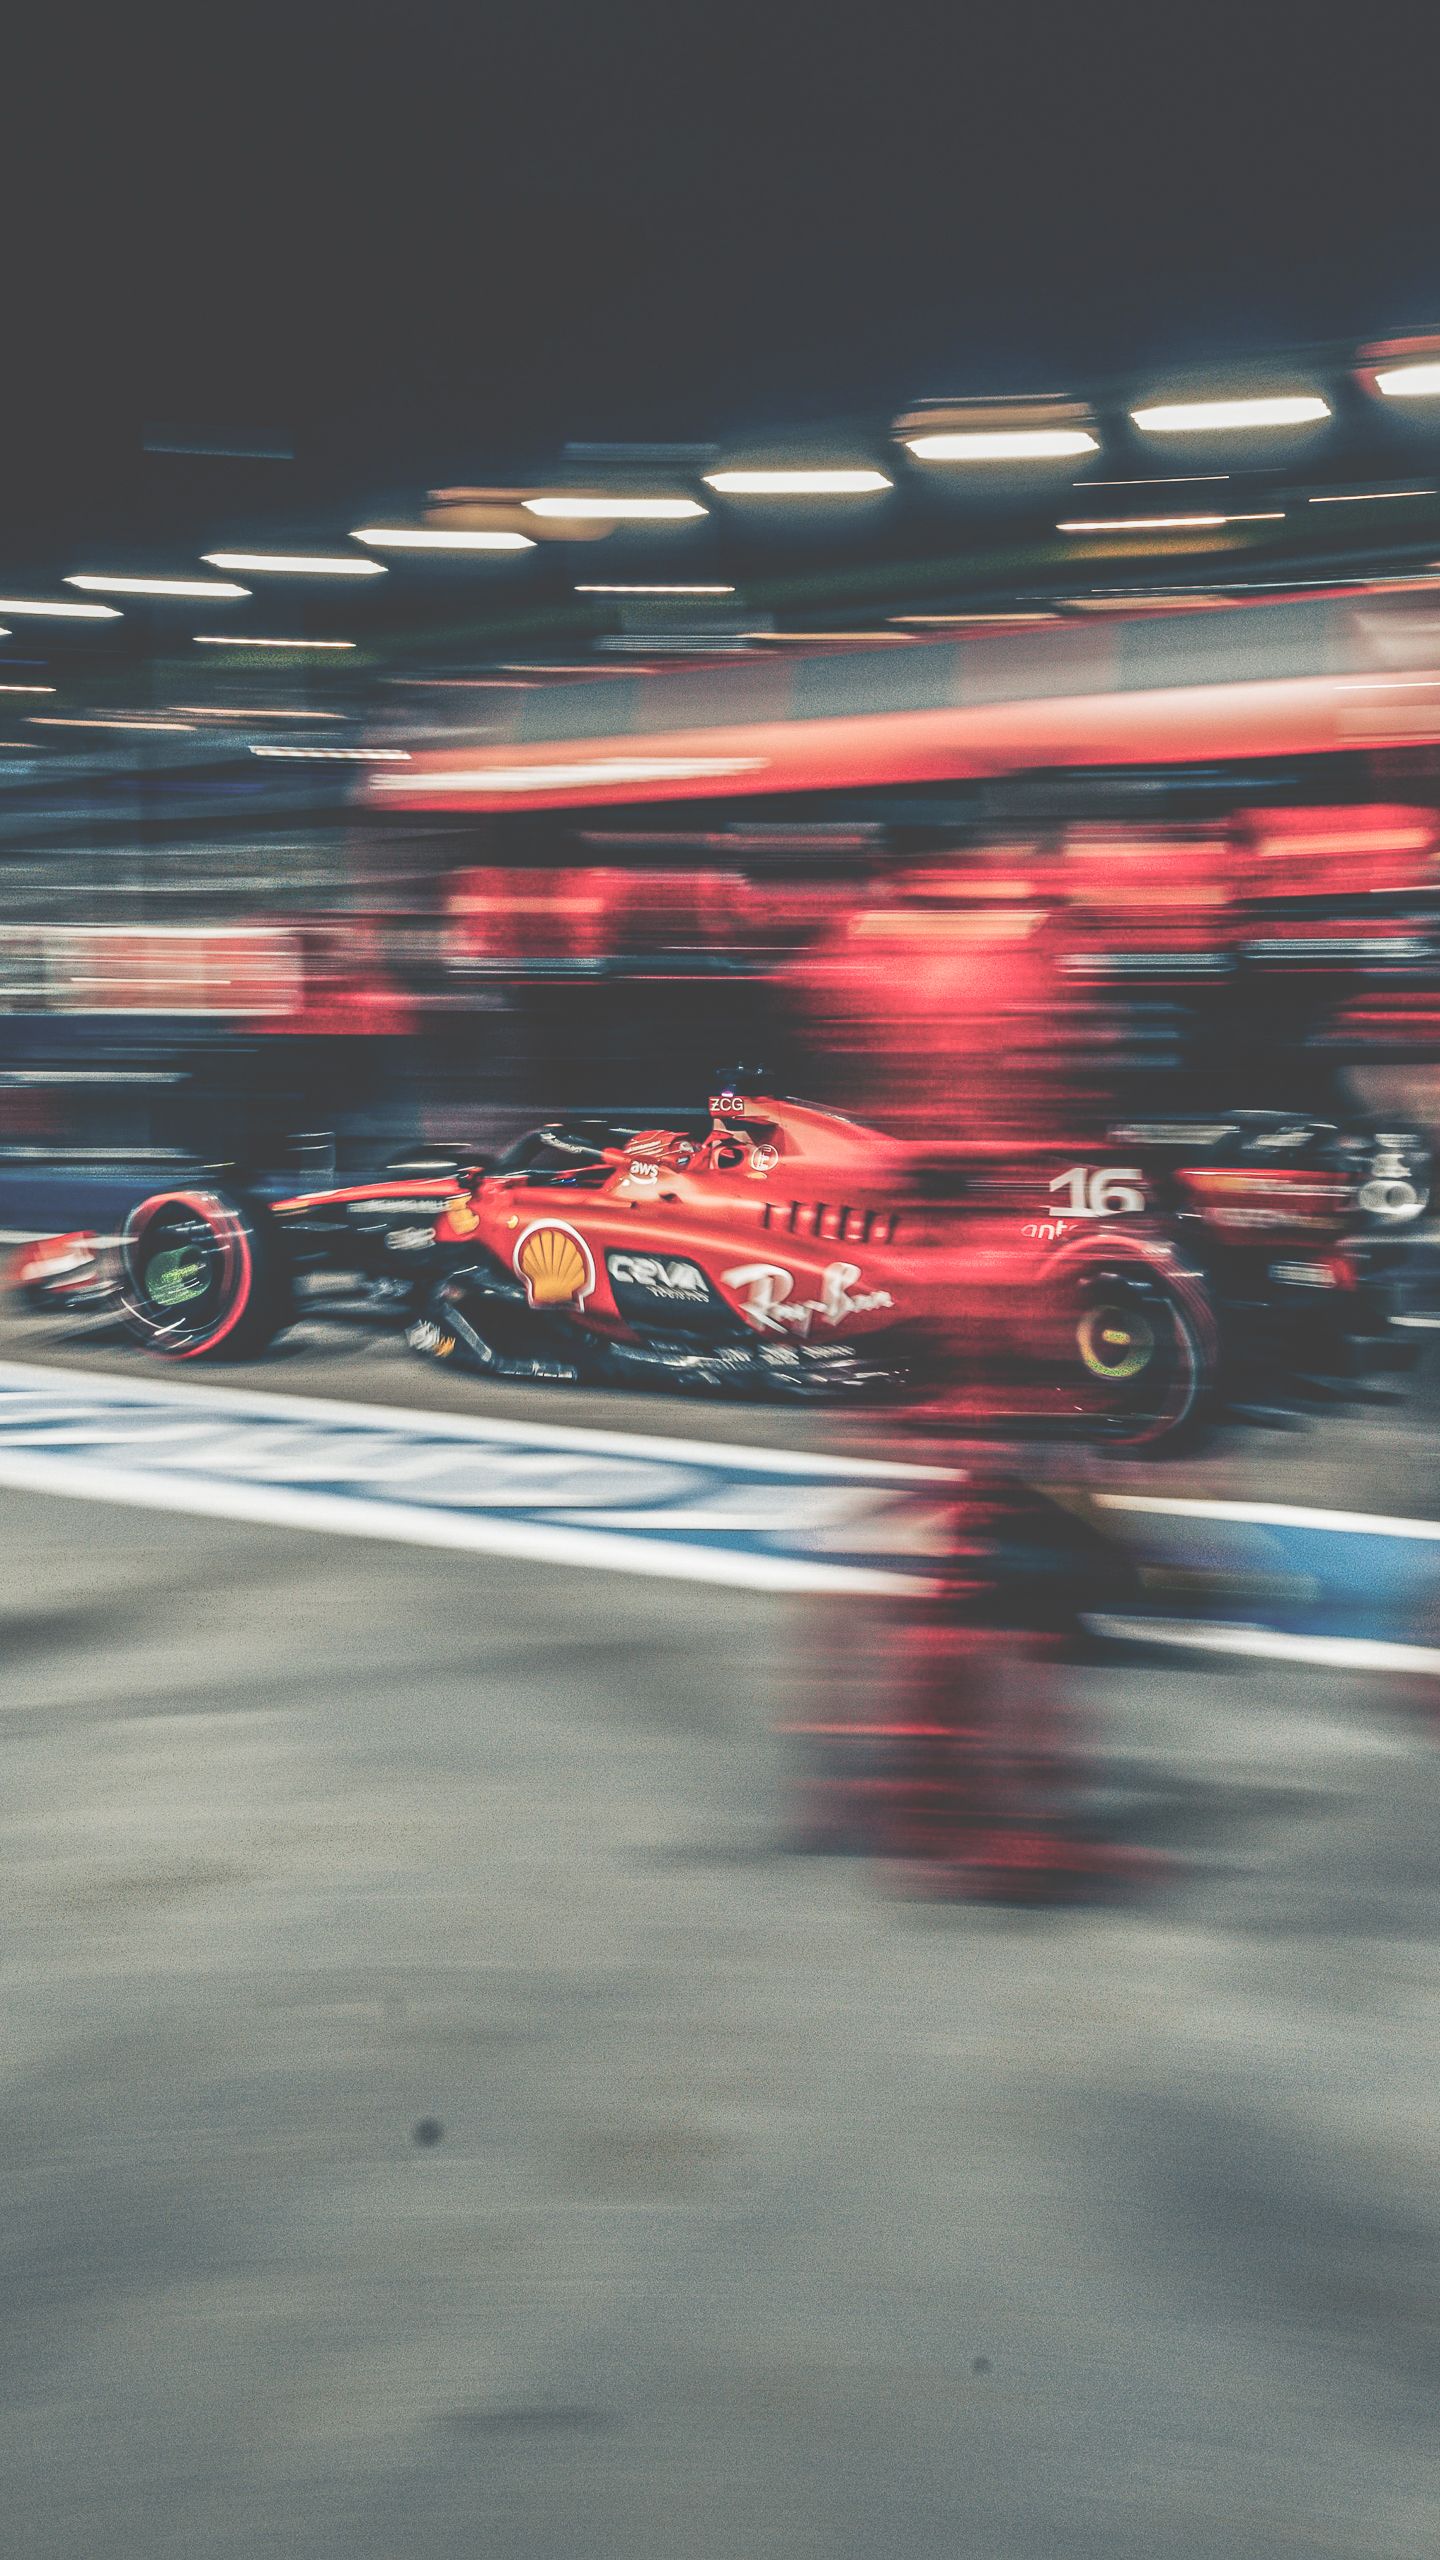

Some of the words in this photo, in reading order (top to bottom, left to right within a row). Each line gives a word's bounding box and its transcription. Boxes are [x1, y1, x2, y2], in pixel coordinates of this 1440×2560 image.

[710, 1097, 744, 1111] ZCG
[630, 1160, 659, 1178] aws
[1049, 1167, 1145, 1218] 16
